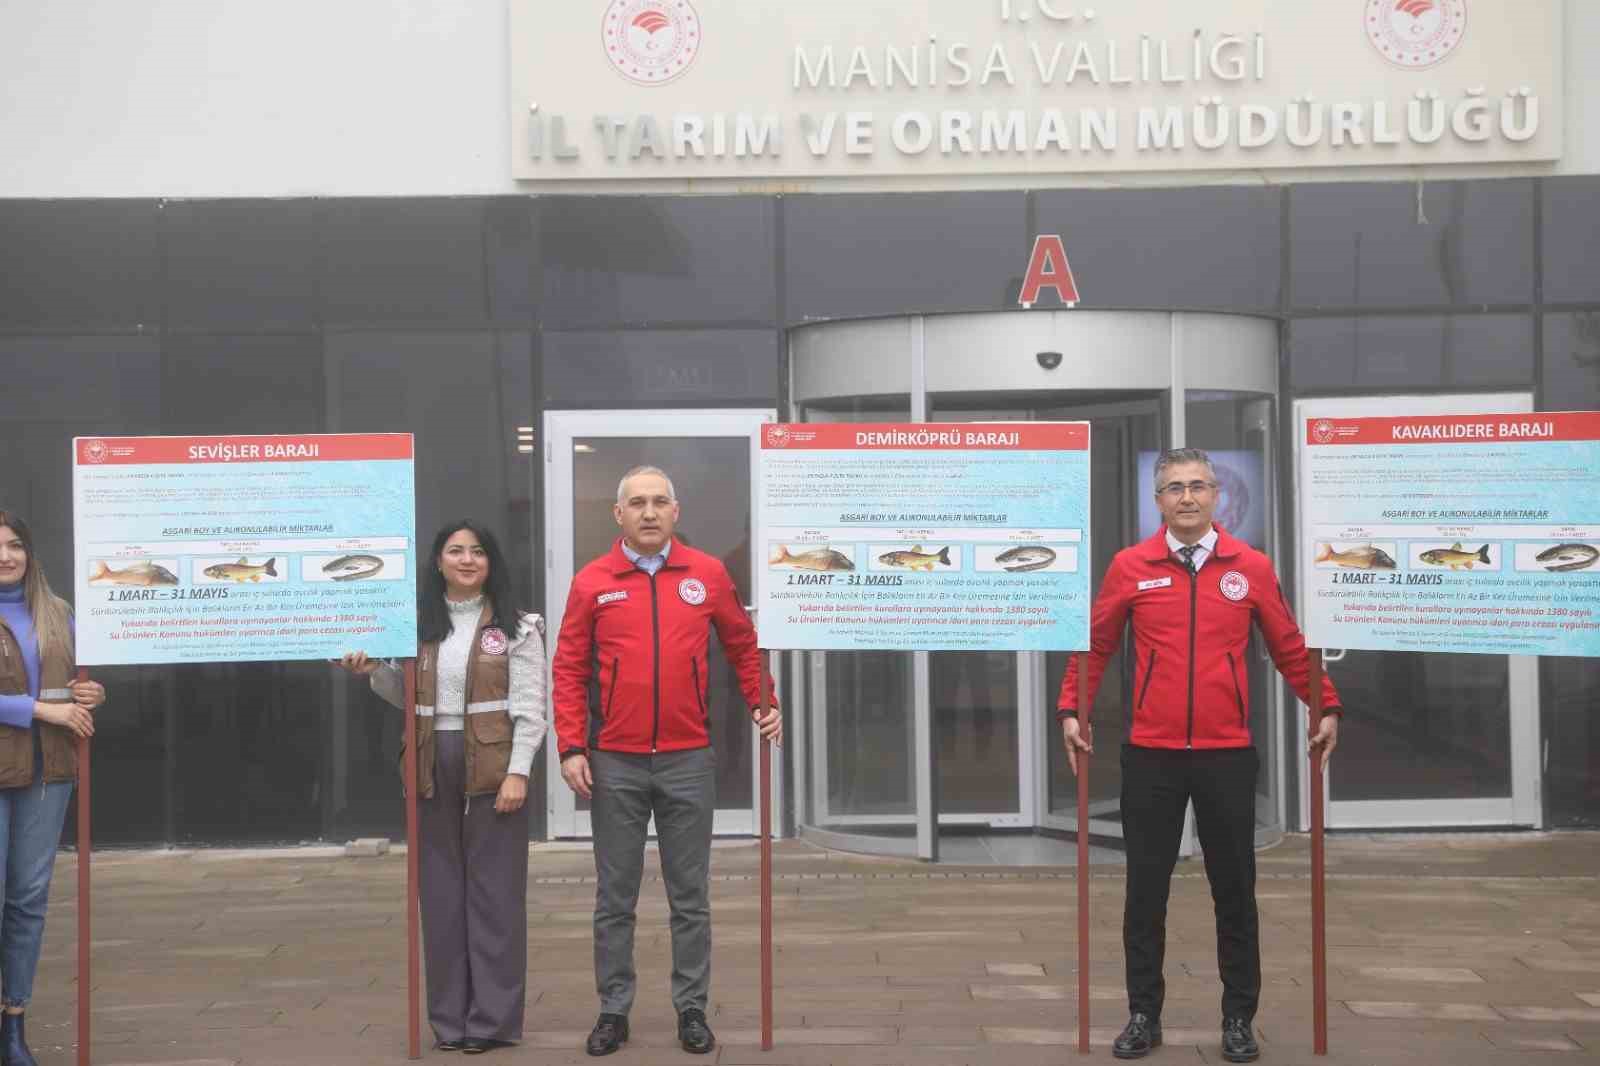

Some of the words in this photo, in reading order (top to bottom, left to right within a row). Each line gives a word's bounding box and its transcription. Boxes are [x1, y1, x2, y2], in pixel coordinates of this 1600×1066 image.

[792, 33, 1017, 88] MANİSA
[1030, 28, 1266, 84] VALİLİĞİ
[526, 102, 580, 160] İL
[595, 111, 785, 160] TARIM
[801, 110, 873, 157] VE
[891, 106, 1117, 156] ORMAN
[1135, 86, 1540, 151] MÜDÜRLÜĞÜ
[1018, 234, 1081, 304] A
[855, 429, 961, 446] DEMİRKÖPRÜ
[966, 431, 1020, 446] BARAJI
[1391, 424, 1494, 440] KAVAKLIDERE
[1499, 422, 1554, 437] BARAJI
[188, 444, 260, 461] SEVİŞLER
[264, 443, 320, 458] BARAJI
[786, 575, 795, 585] 1
[797, 574, 835, 585] MART
[847, 574, 861, 585] 31
[864, 575, 904, 586] MAYIS
[1331, 572, 1338, 584] 1
[1342, 572, 1377, 585] MART
[1388, 573, 1403, 585] 31
[1406, 573, 1444, 586] MAYIS
[107, 590, 115, 601] 1
[119, 589, 157, 601] MART
[171, 588, 185, 600] 31
[190, 587, 229, 600] MAYIS
